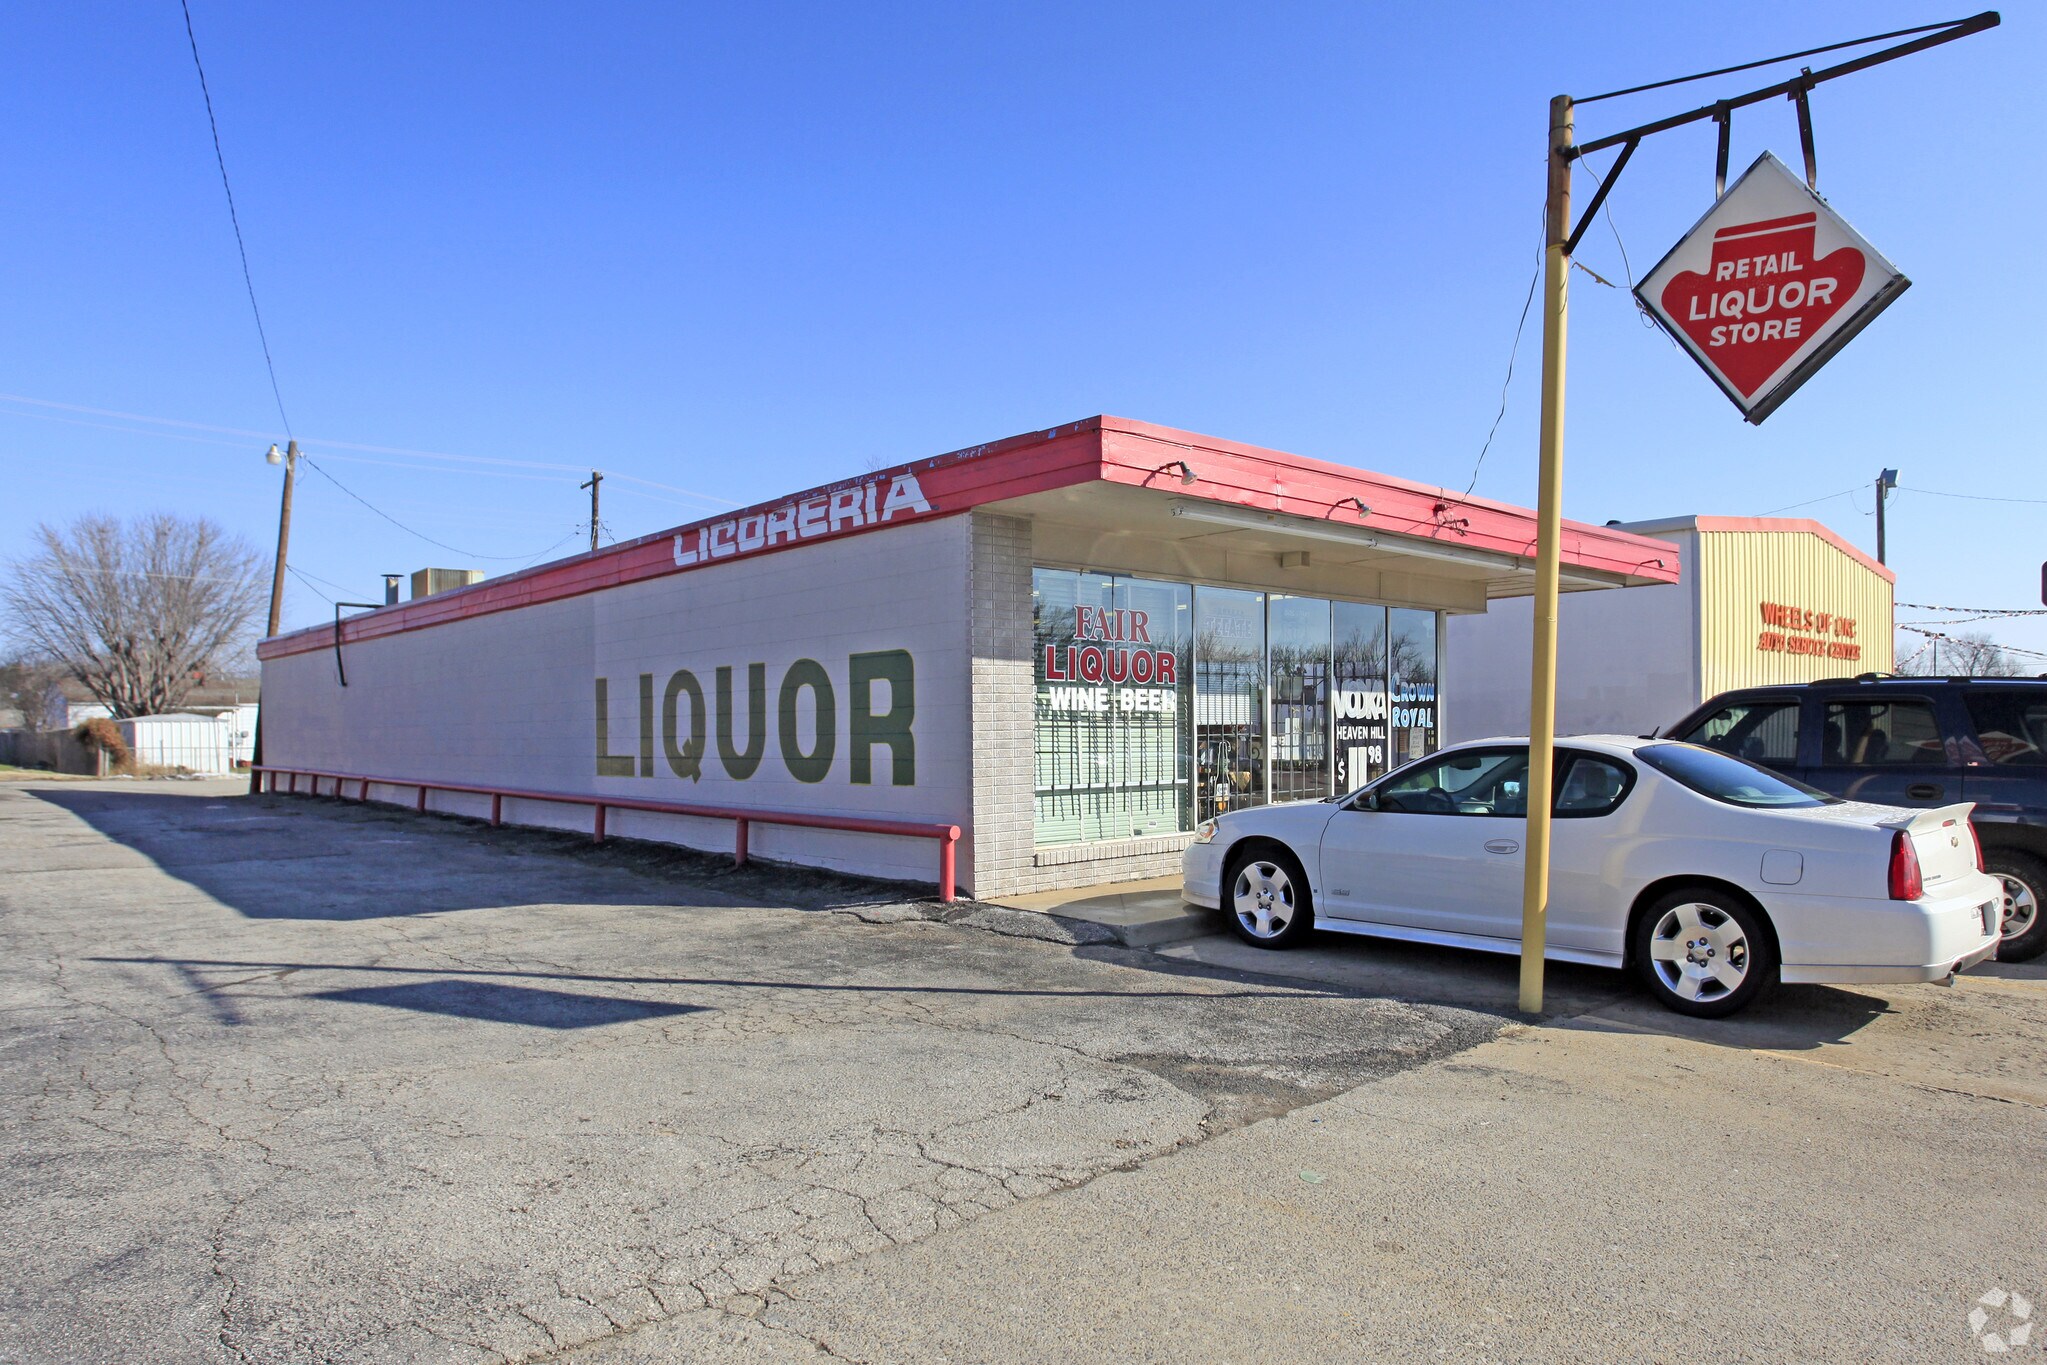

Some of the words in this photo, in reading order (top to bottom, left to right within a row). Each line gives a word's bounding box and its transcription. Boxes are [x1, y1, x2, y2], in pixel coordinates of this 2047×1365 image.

[1716, 251, 1803, 282] RETAIL
[1689, 277, 1838, 320] LIQUOR
[1709, 317, 1802, 347] STORE
[673, 472, 932, 567] LICORERIA
[1073, 604, 1151, 644] FAIR
[1760, 601, 1813, 632] WHEELS
[1816, 612, 1832, 634] OF
[1757, 631, 1785, 653] AUTO
[1787, 635, 1826, 657] SERVICE
[1045, 644, 1176, 686] LIQUOR
[1049, 687, 1109, 711] WINE
[1120, 688, 1175, 712] BEER
[1333, 676, 1387, 720] VODKA
[1391, 672, 1434, 702] CROWN
[595, 648, 916, 786] LIQUOR
[1336, 726, 1368, 740] HEAVEN
[1370, 726, 1386, 740] HILL
[1392, 706, 1433, 728] ROYAL
